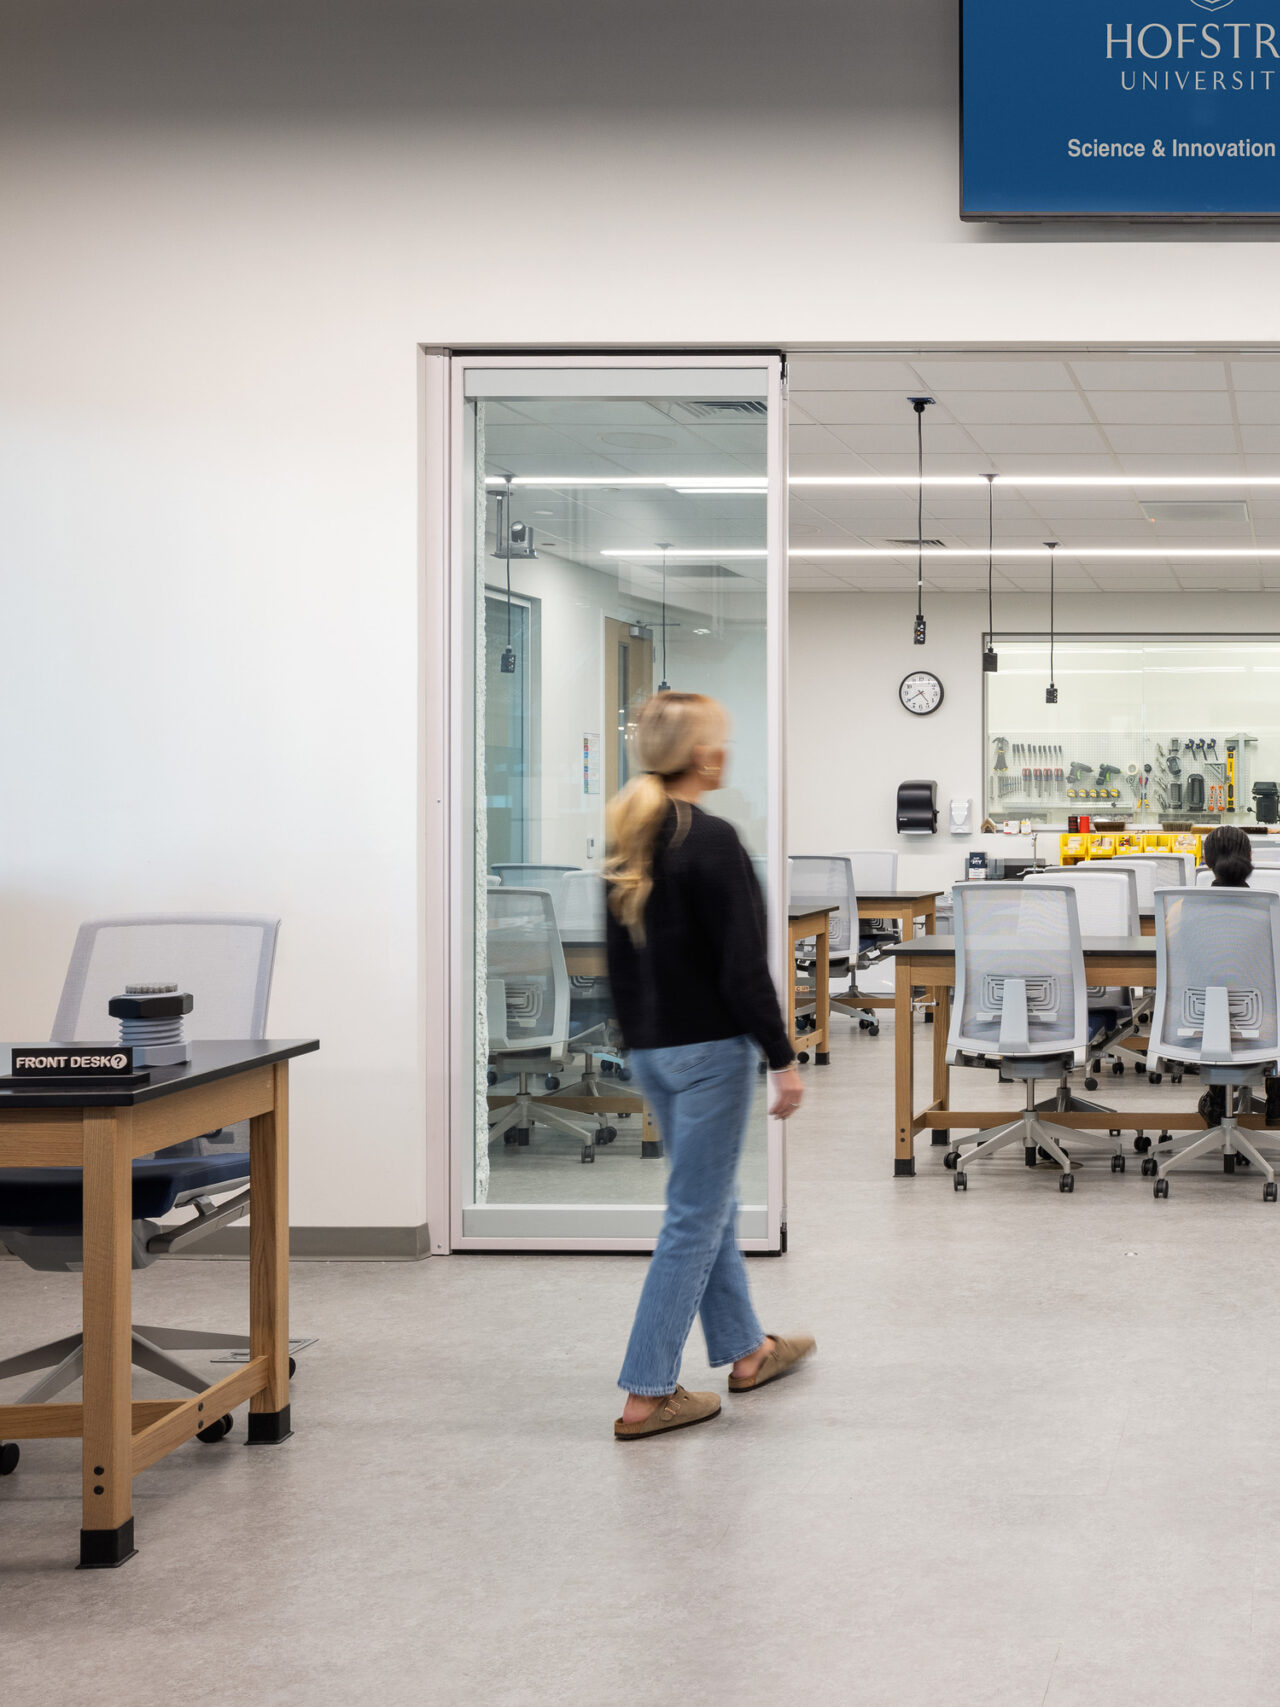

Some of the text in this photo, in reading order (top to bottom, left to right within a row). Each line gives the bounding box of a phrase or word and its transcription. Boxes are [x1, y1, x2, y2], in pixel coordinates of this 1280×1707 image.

[1067, 138, 1146, 158] Science
[1151, 138, 1166, 158] &
[1172, 138, 1276, 158] Innovation
[16, 1056, 68, 1069] FRONT
